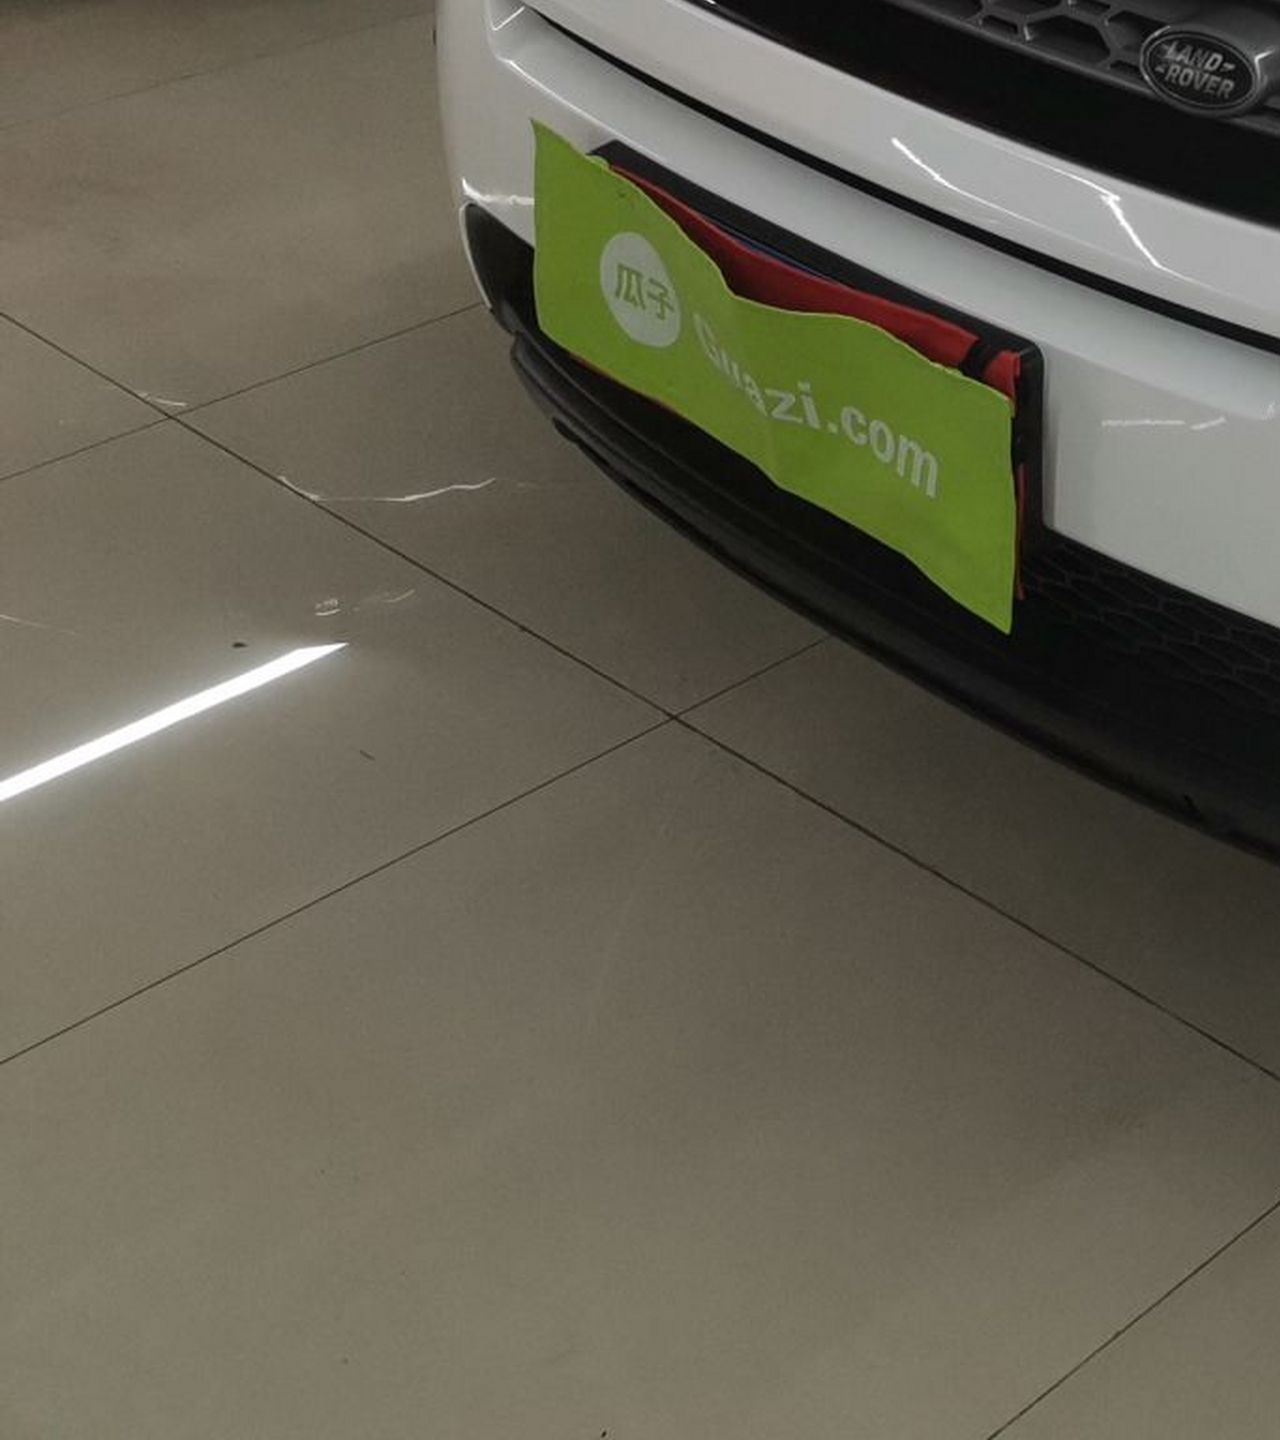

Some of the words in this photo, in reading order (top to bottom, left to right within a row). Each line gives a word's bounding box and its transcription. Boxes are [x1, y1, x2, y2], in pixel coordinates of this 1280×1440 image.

[1162, 41, 1224, 73] LAND
[1164, 63, 1235, 99] ROVER
[615, 261, 676, 322] 瓜子
